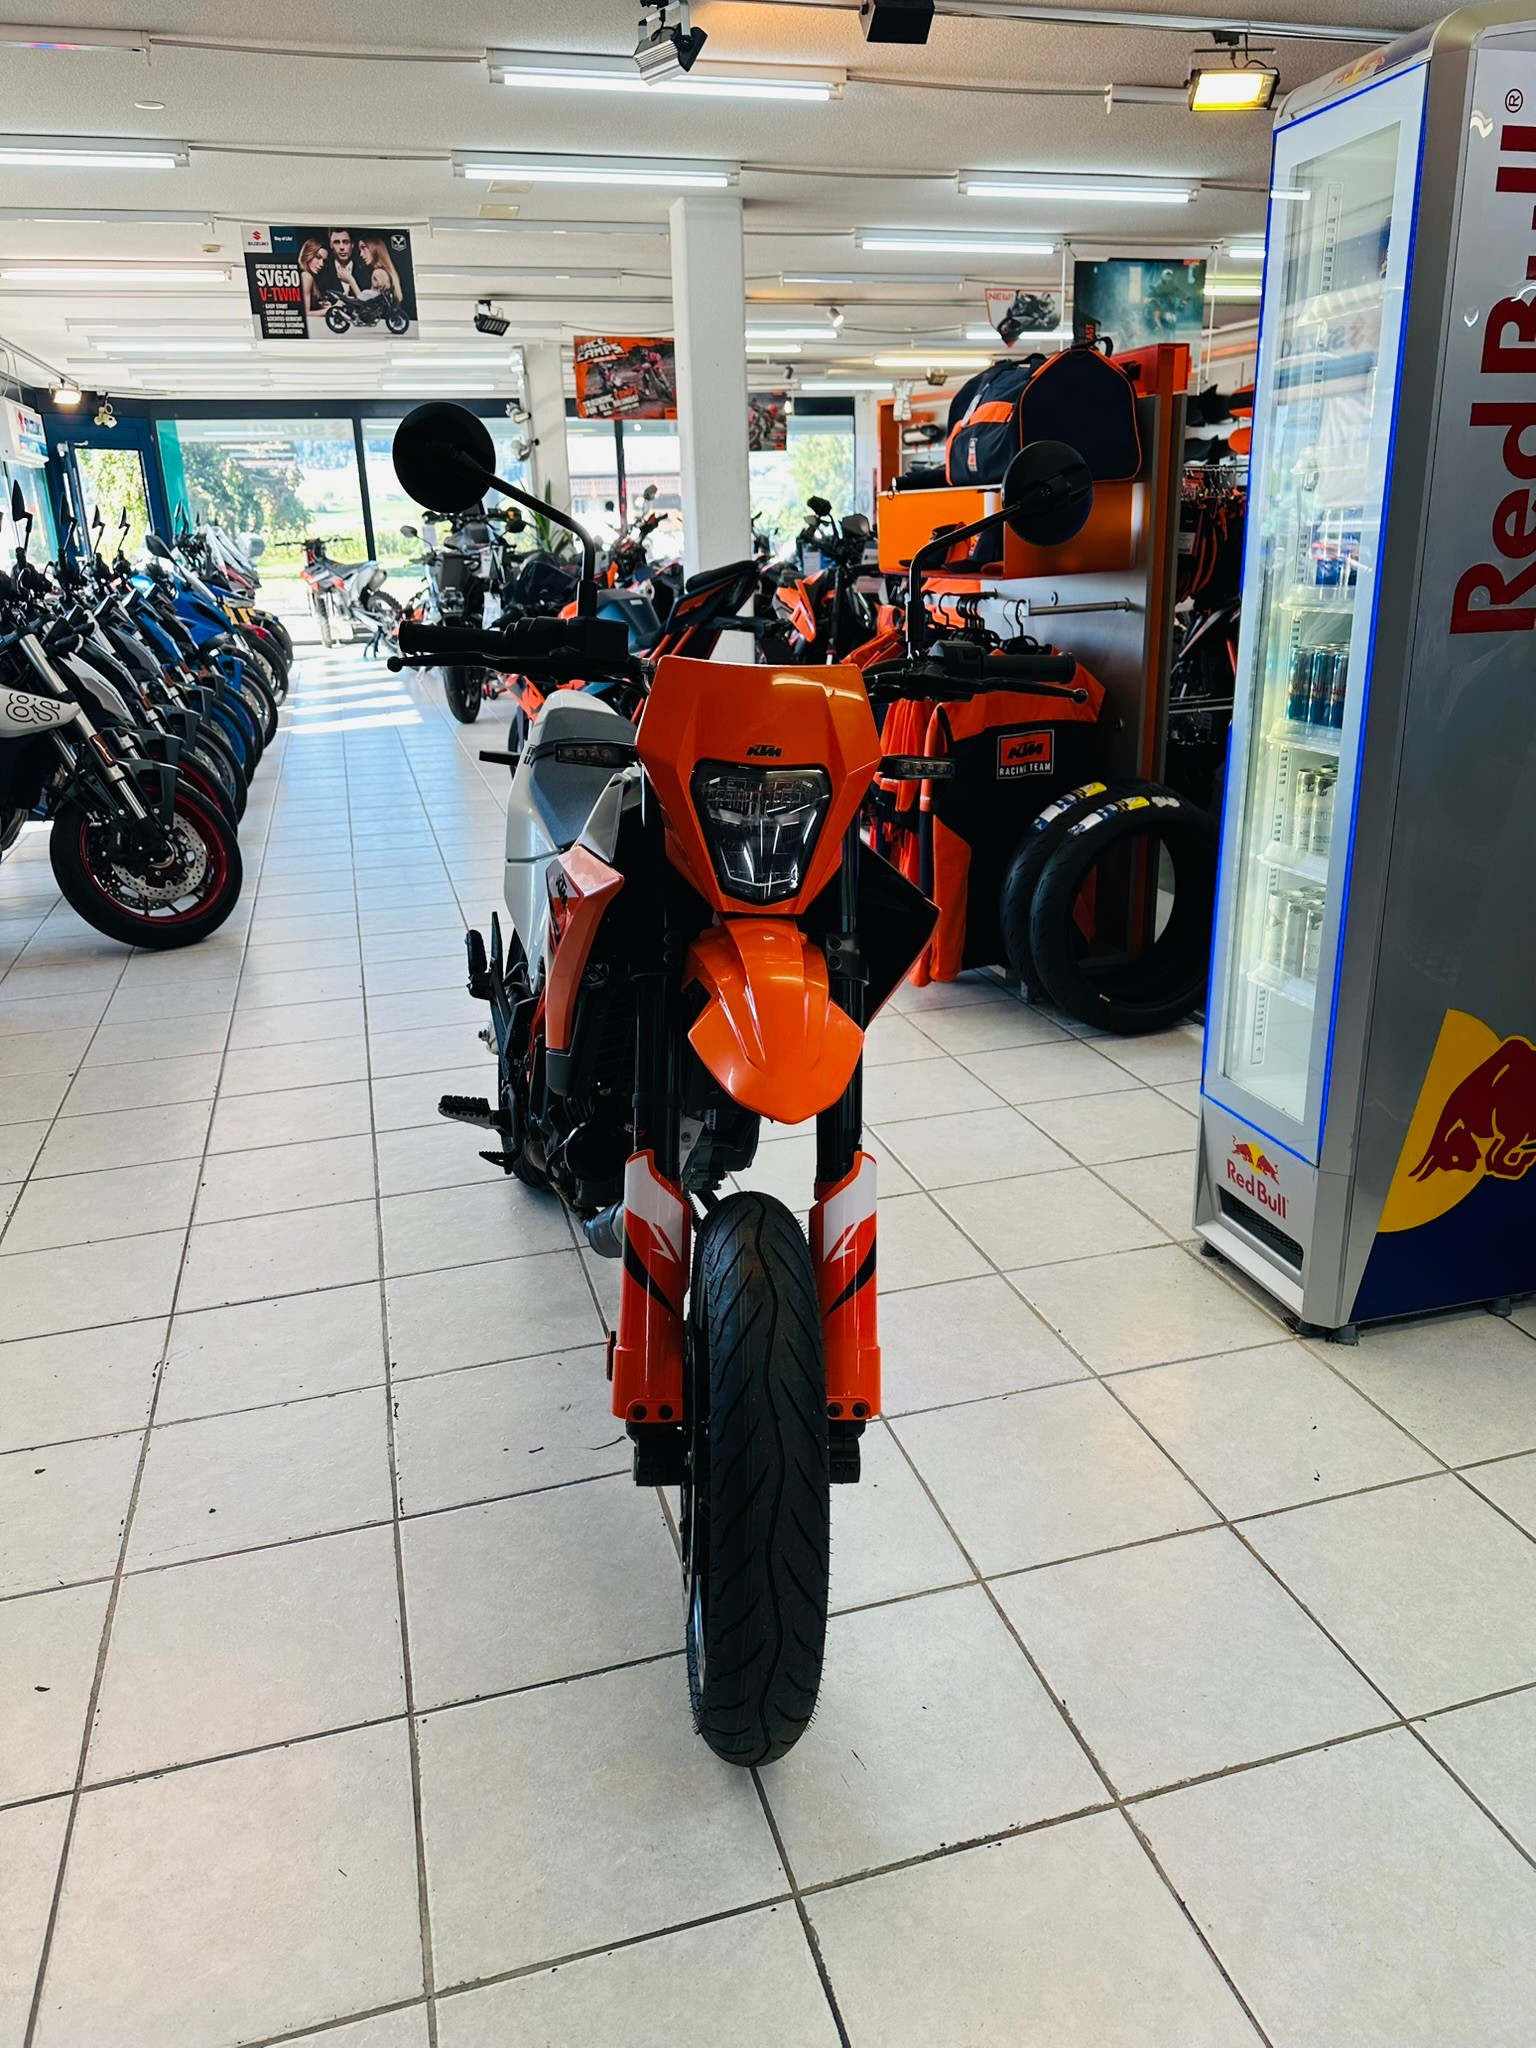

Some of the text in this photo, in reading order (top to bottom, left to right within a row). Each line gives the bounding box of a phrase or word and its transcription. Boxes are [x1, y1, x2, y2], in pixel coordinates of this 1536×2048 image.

[256, 269, 300, 287] SV650
[259, 287, 301, 301] V-TWIN
[577, 343, 625, 361] CAMPS
[1450, 402, 1536, 634] Red
[746, 744, 782, 757] KTM
[1007, 741, 1044, 760] KTM
[1000, 762, 1051, 776] RACING TEAM
[1227, 1158, 1286, 1219] Red Bull
